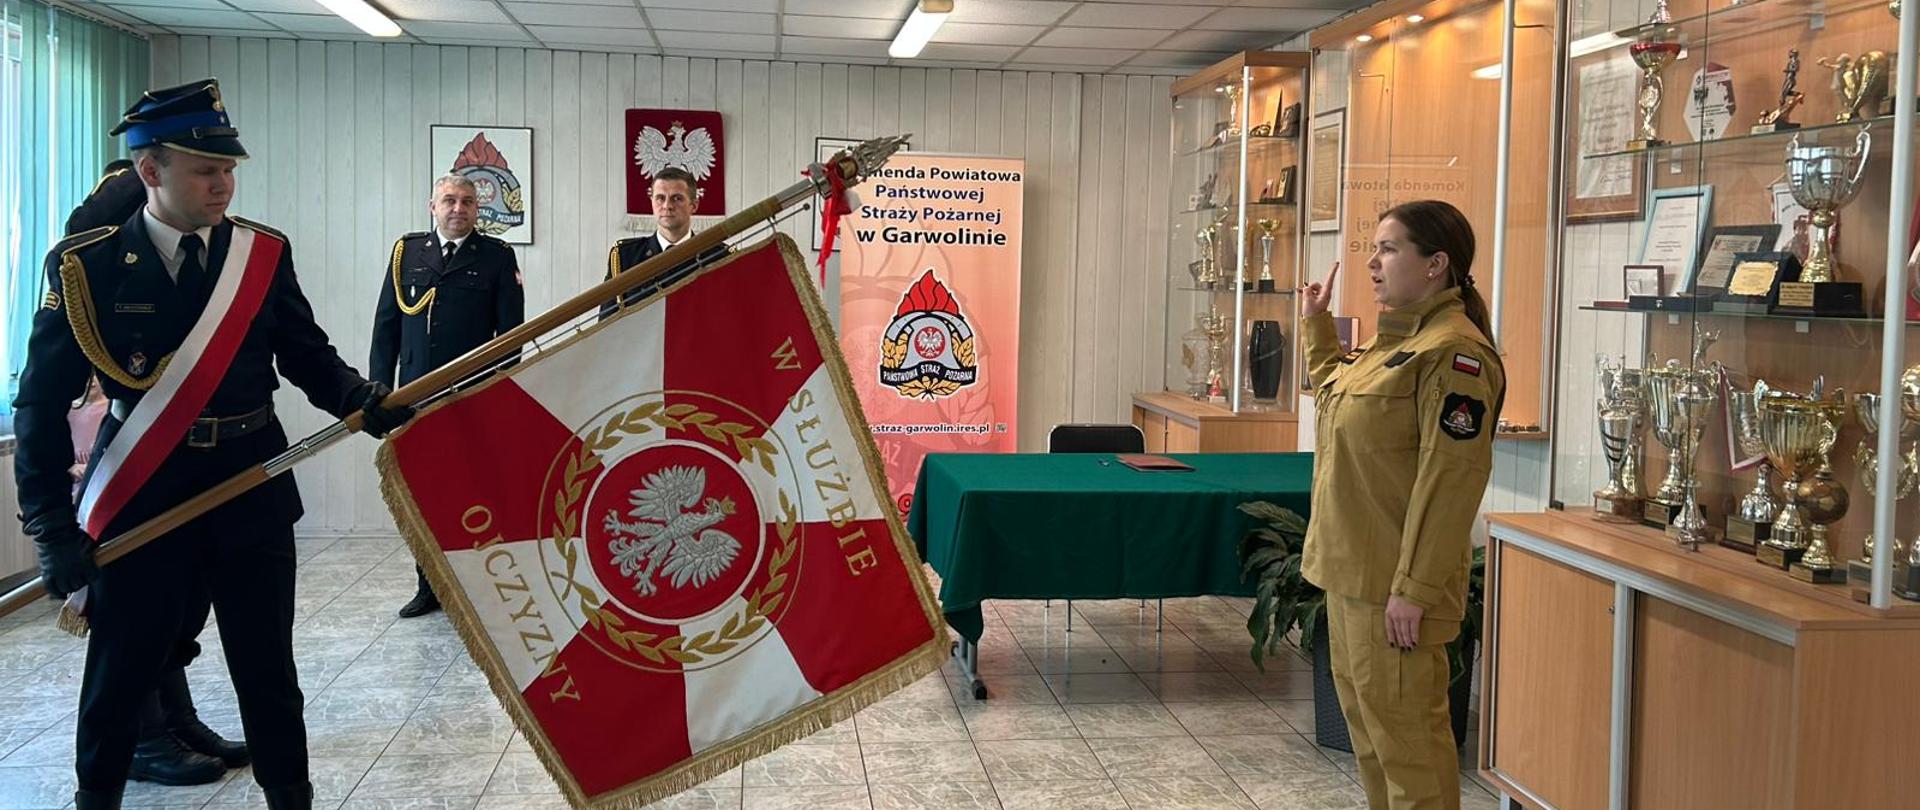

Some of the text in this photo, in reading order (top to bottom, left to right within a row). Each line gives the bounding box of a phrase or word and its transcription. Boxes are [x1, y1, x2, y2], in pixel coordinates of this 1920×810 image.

[868, 166, 1021, 182] menda Powiatowa
[875, 184, 985, 204] Państwowej
[861, 205, 1001, 225] Straży Pożarnej
[857, 227, 1007, 245] w Garwolinie
[870, 424, 989, 434] .straz-garwolin.ires.pl
[770, 336, 878, 577] W SŁUŻBIE
[461, 505, 581, 703] OJCZYZNY
